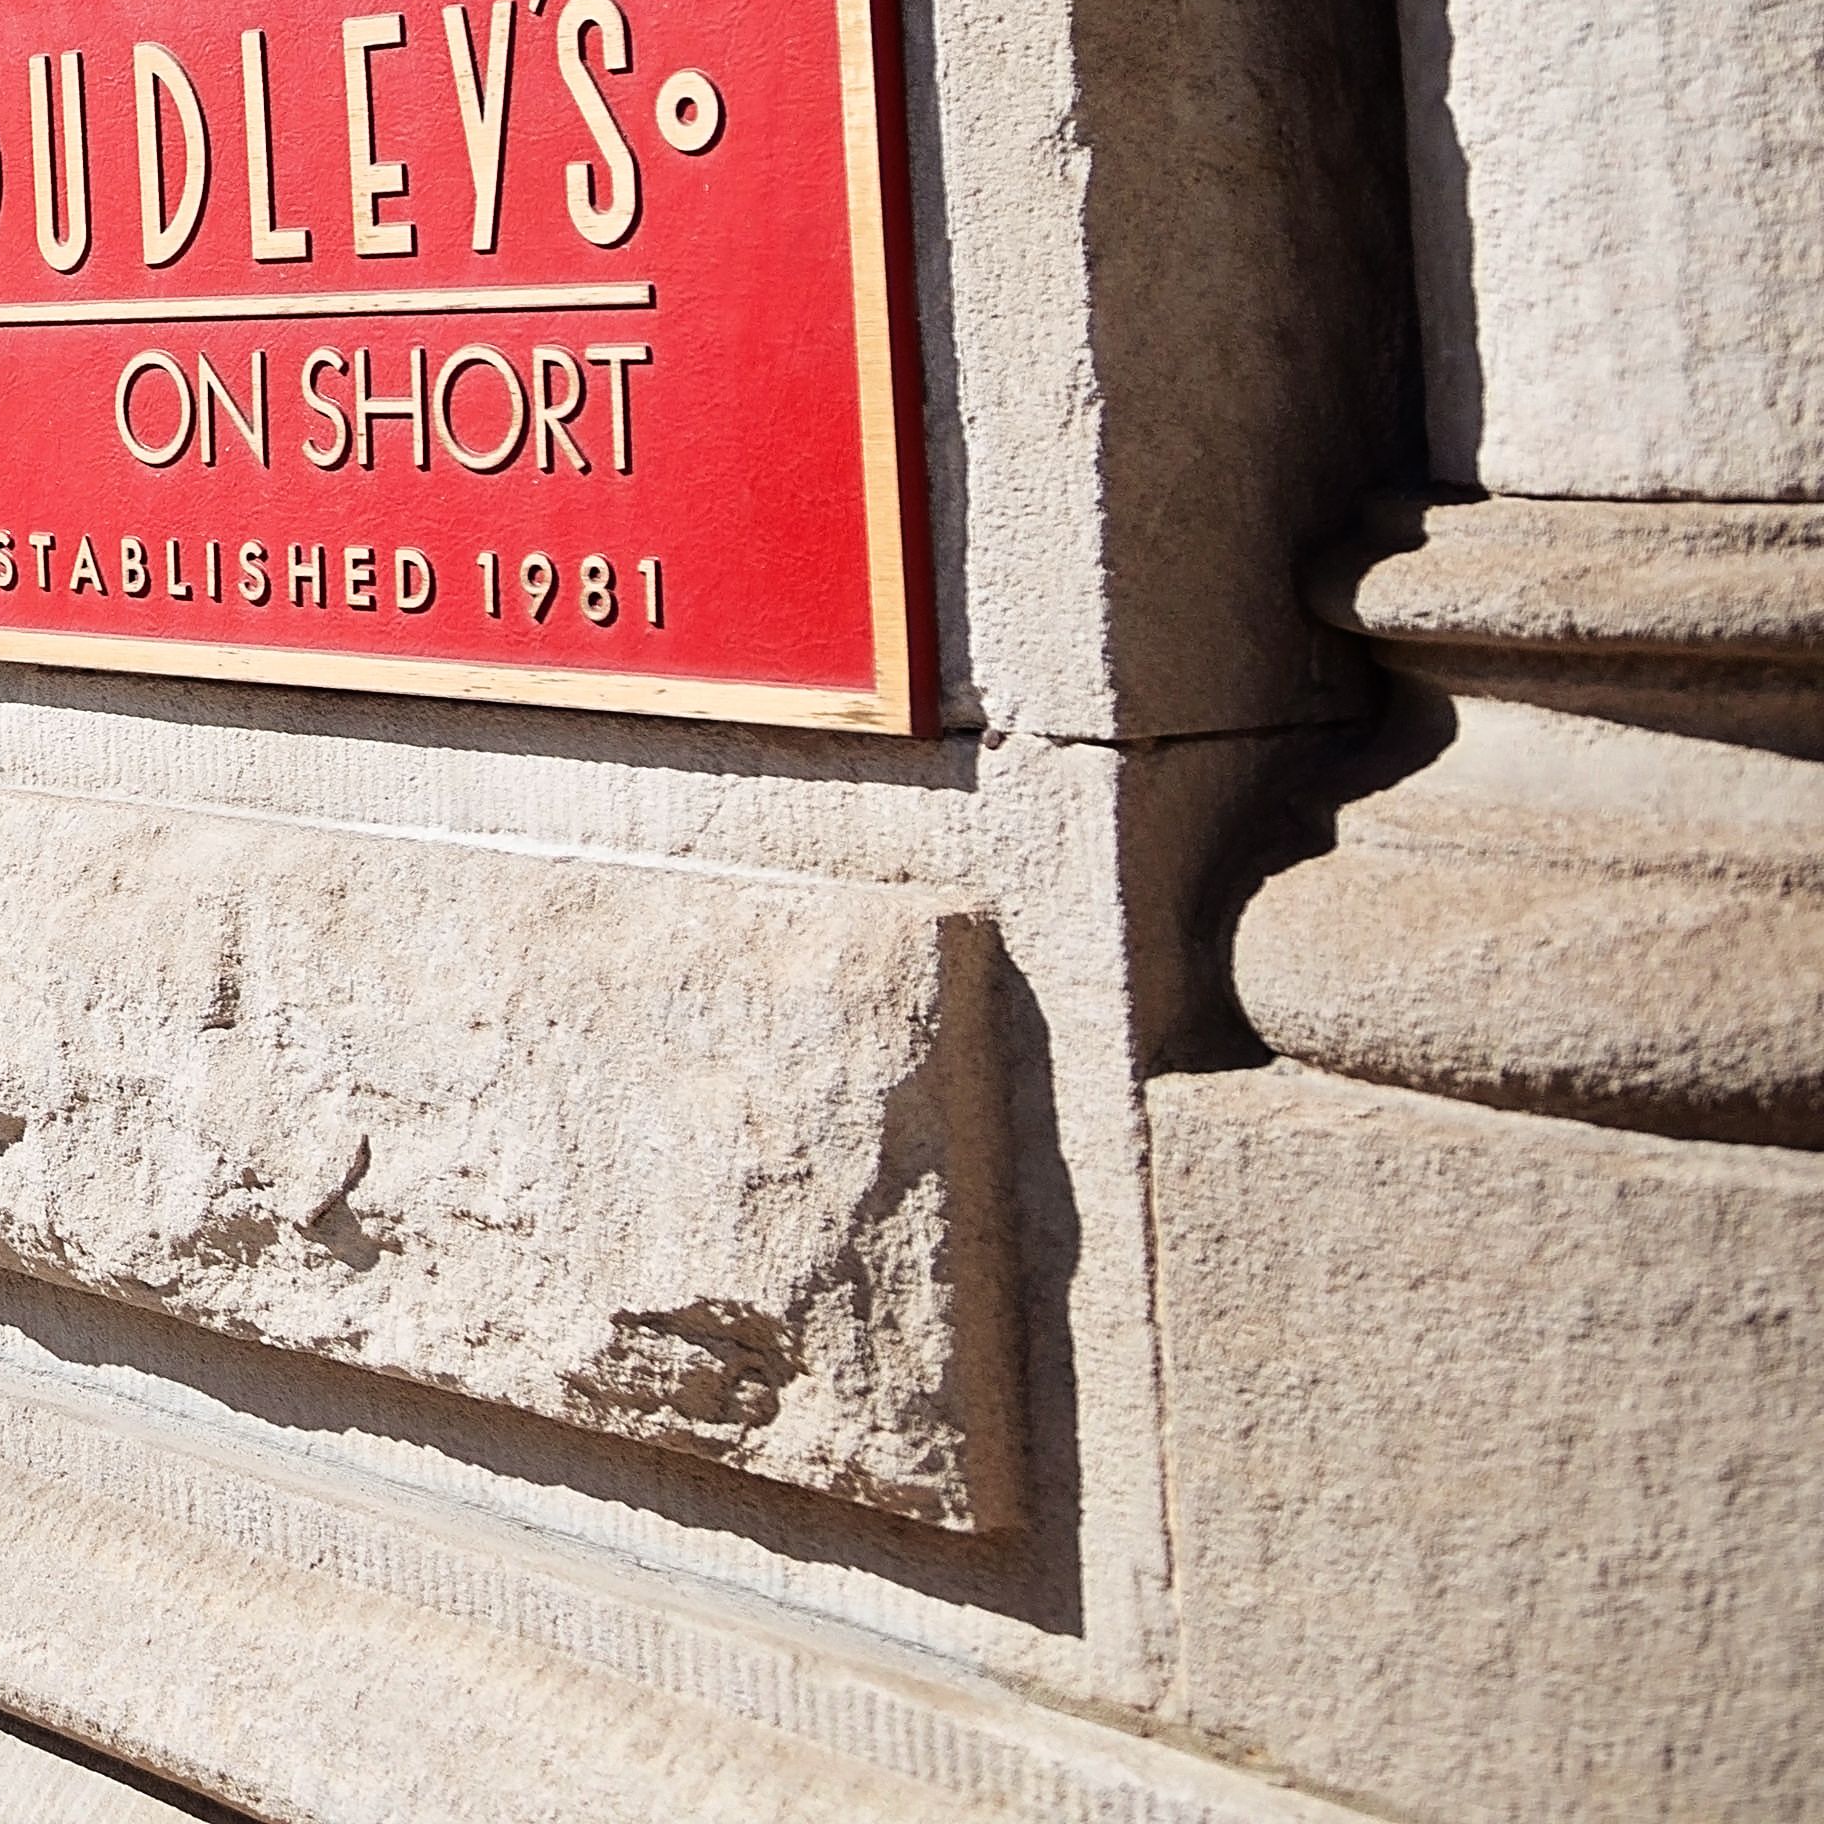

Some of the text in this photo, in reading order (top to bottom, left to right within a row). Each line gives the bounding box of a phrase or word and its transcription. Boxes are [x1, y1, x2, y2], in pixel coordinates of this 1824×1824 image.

[114, 341, 654, 476] ON SHORT
[476, 550, 667, 630] 1981
